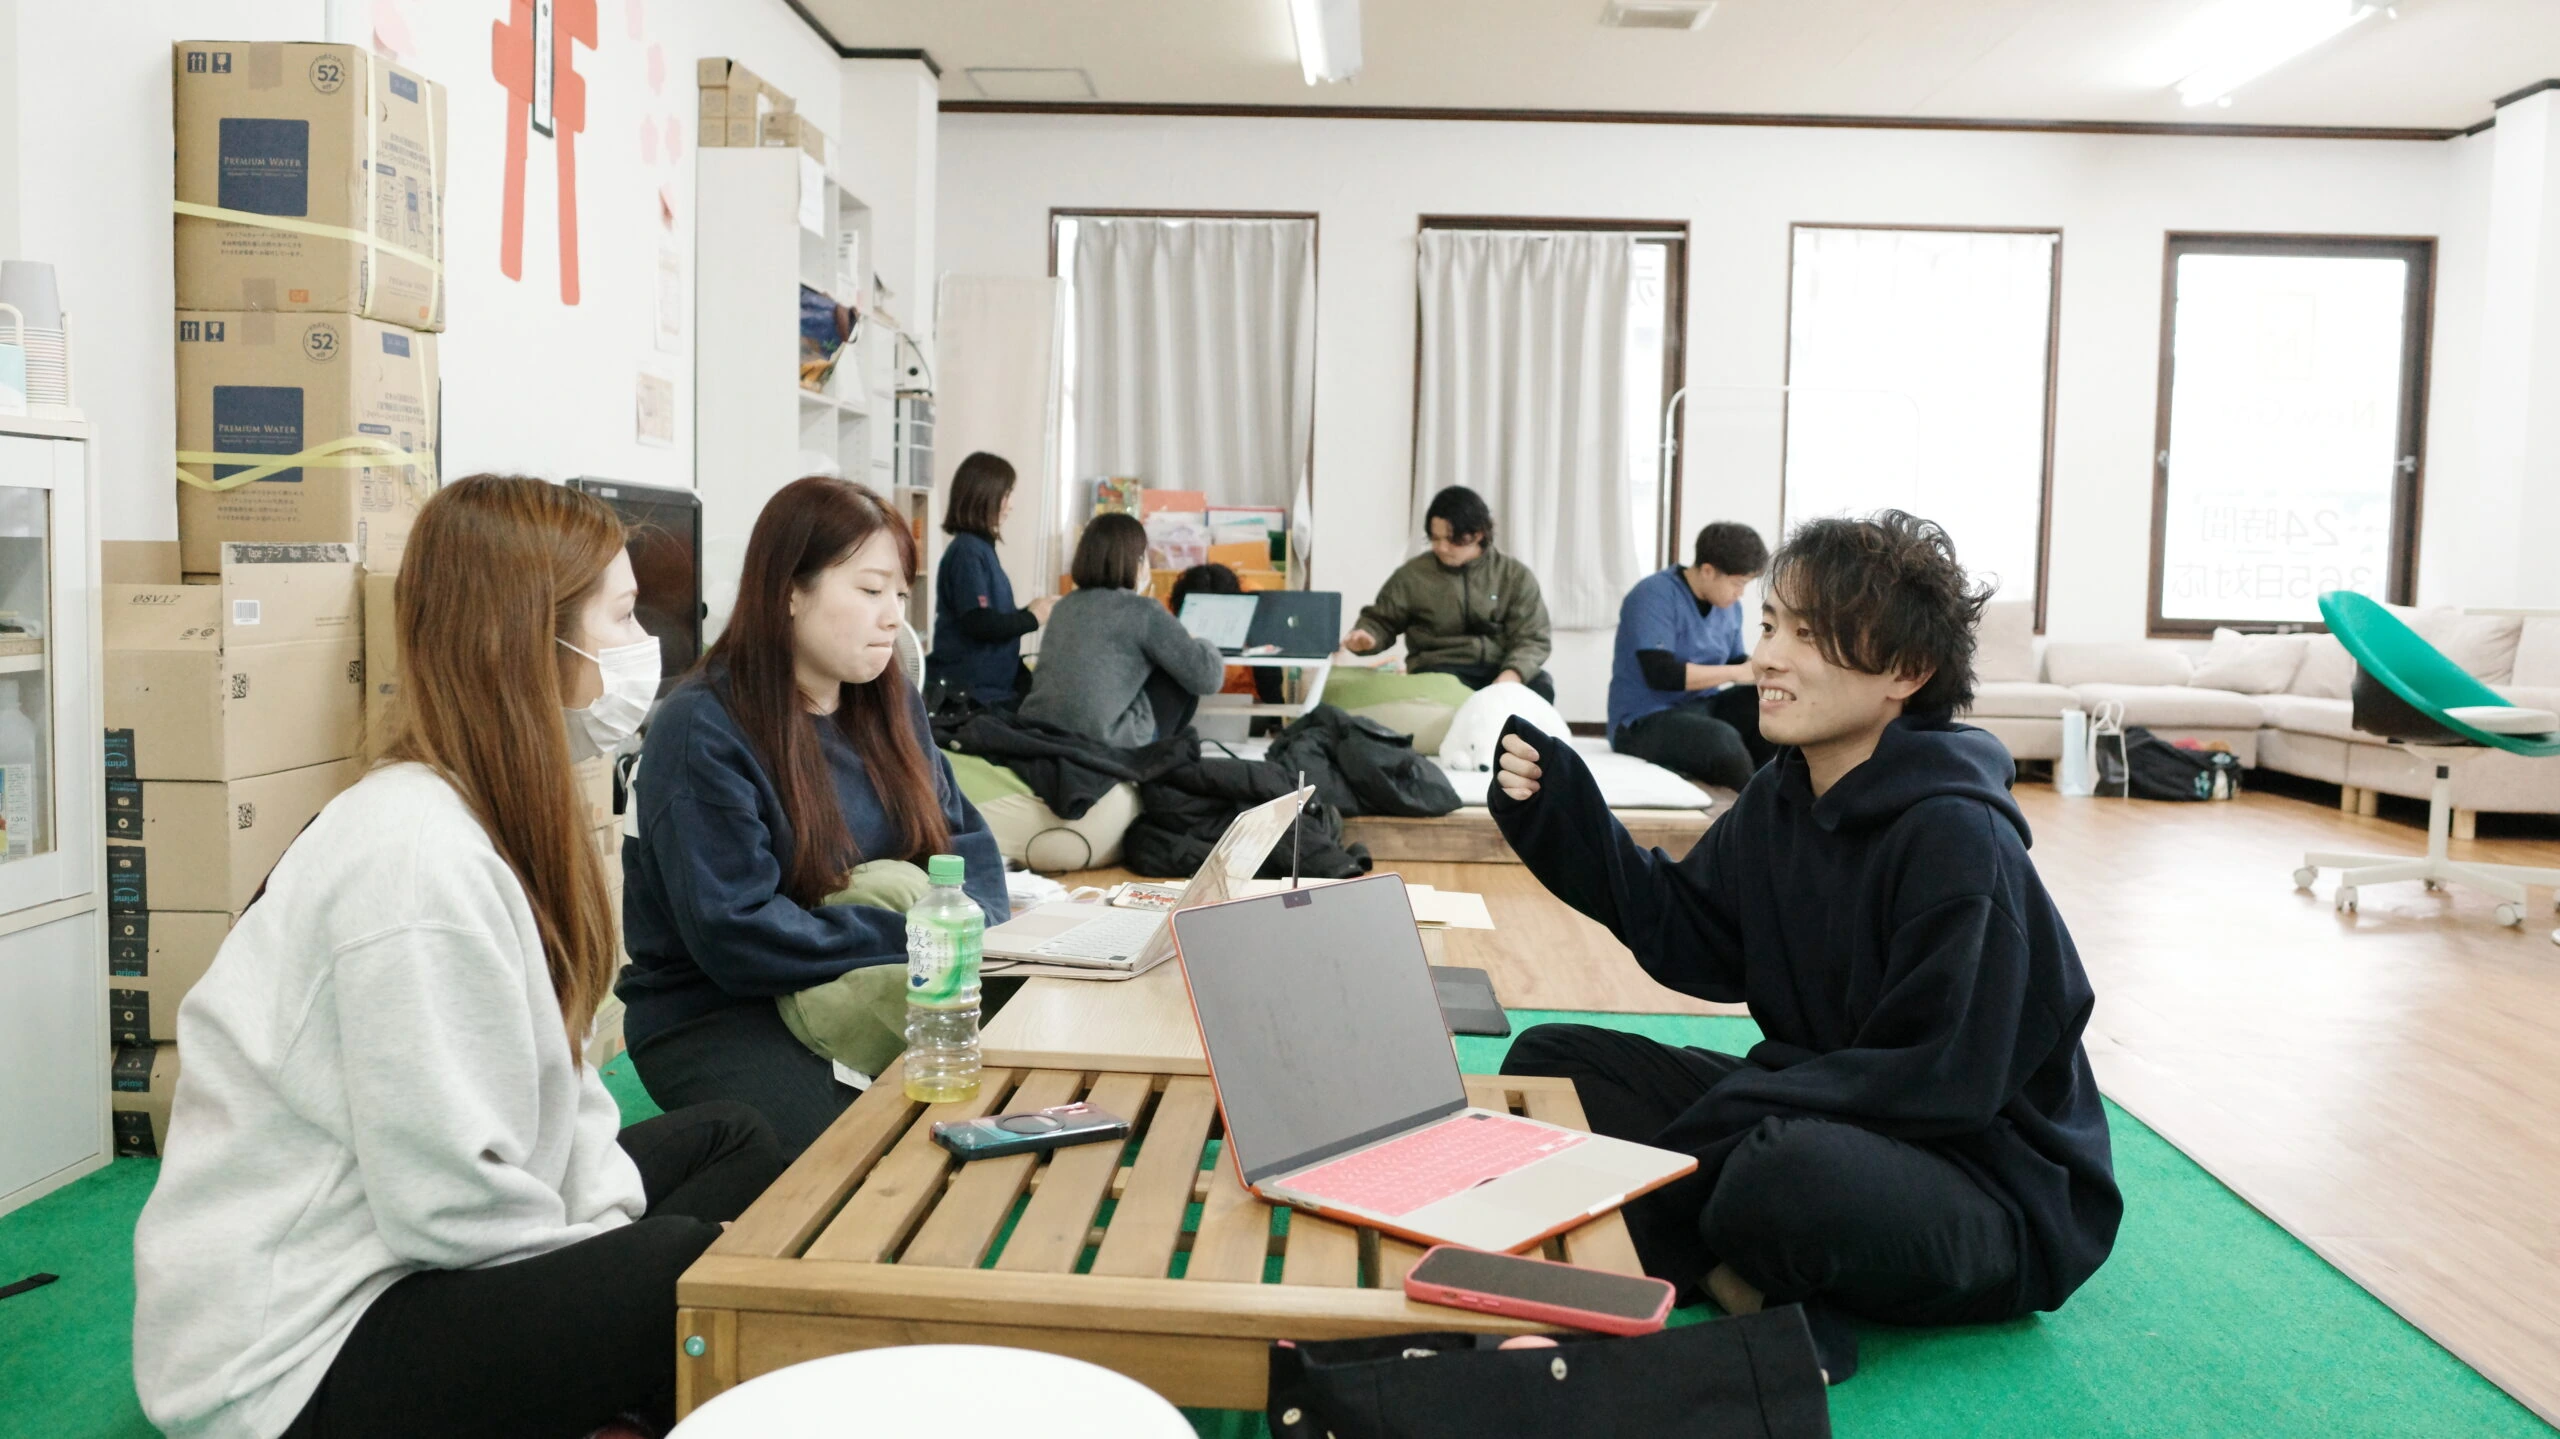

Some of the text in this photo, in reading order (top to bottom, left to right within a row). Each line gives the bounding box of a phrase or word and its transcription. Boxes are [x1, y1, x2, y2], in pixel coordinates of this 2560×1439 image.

[318, 65, 339, 82] 52
[224, 156, 302, 167] PREMIUM WATER
[311, 333, 333, 350] 52
[218, 423, 297, 434] PREMIUM WATER
